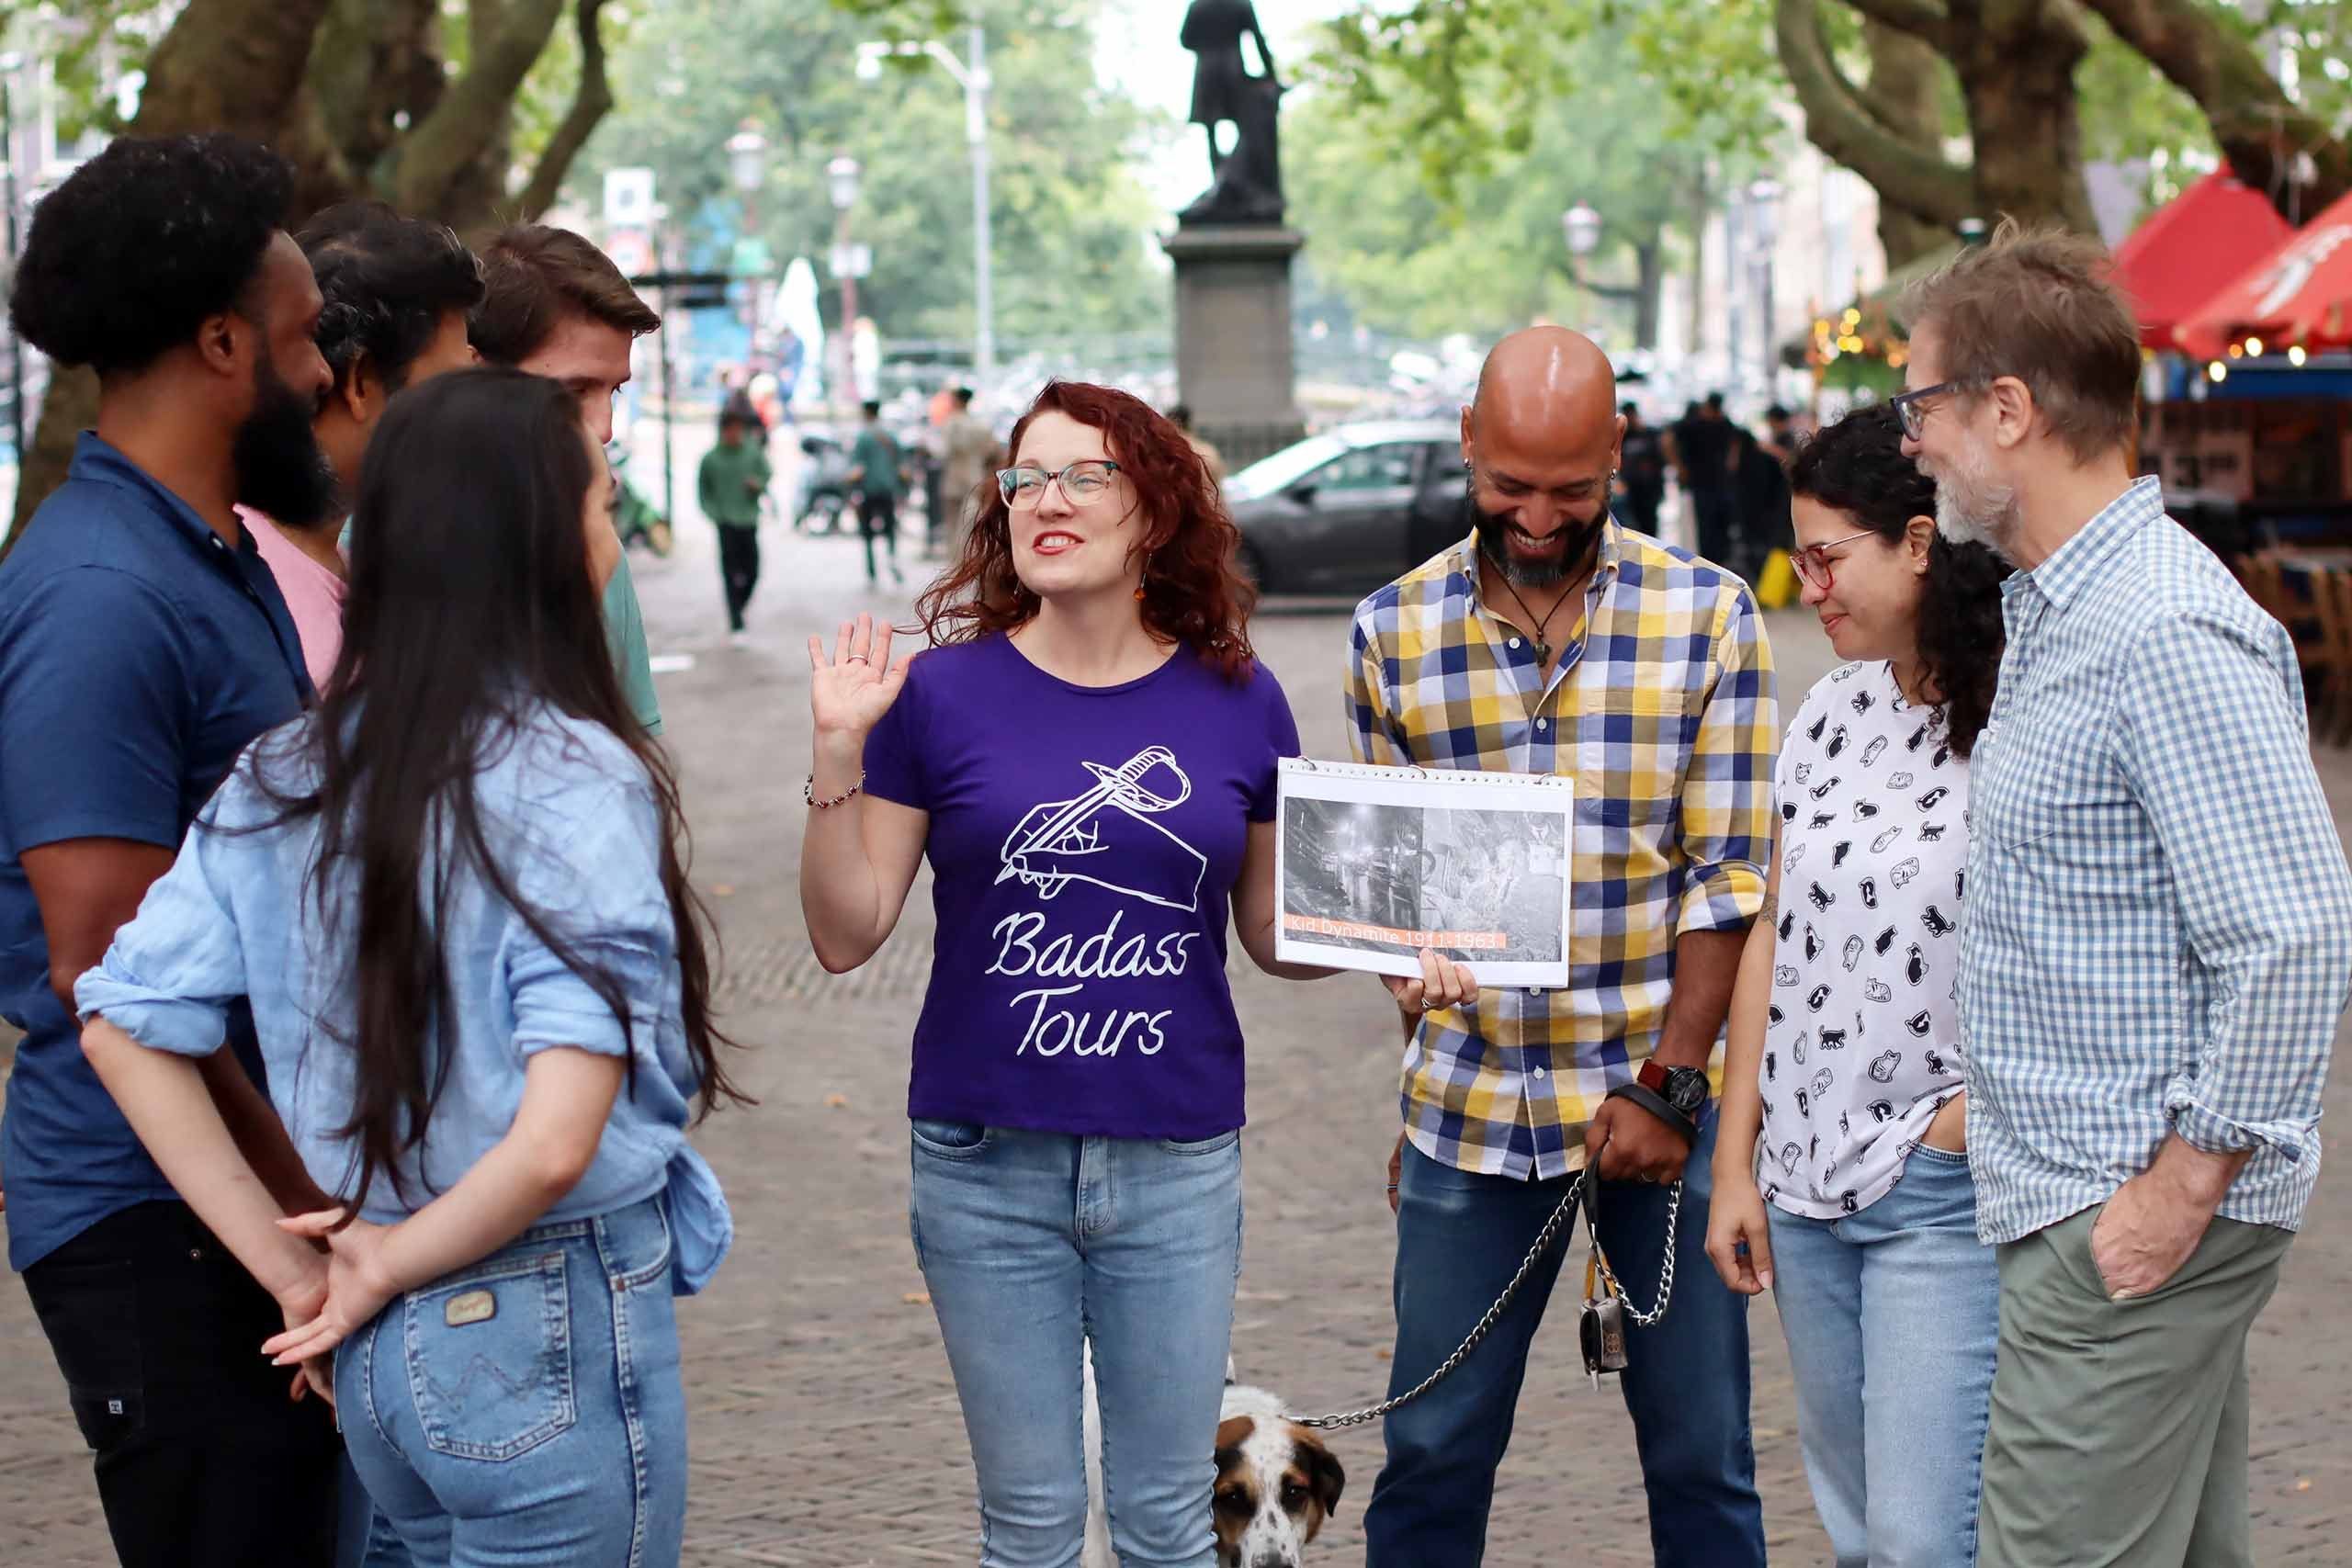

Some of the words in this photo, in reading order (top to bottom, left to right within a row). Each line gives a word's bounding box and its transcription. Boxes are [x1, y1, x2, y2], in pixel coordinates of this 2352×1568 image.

[985, 909, 1200, 978] Badass
[1292, 918, 1315, 932] Kid
[1322, 919, 1399, 942] Dynamite
[1406, 931, 1496, 948] 1911-1963
[1010, 983, 1172, 1057] Tours
